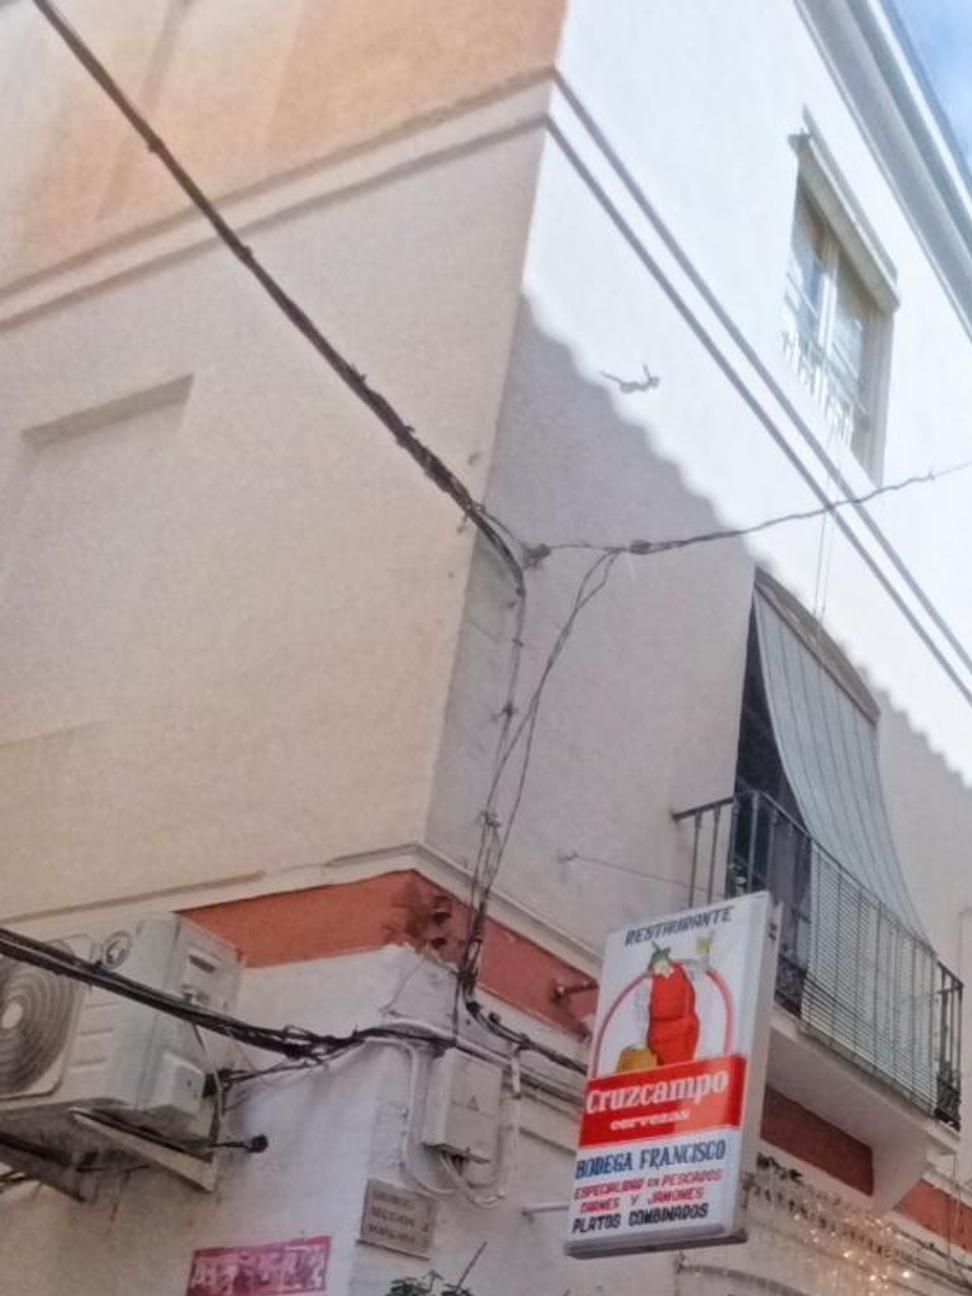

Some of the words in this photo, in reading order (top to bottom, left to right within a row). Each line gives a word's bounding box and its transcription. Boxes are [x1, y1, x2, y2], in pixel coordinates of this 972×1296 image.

[624, 905, 734, 946] RESTAURANTE
[586, 1070, 729, 1114] Cruzcampo
[575, 1152, 633, 1180] BODEGA
[639, 1139, 726, 1170] FRANCISCO
[660, 1168, 722, 1187] PESCADOS
[571, 1213, 622, 1234] PLATOS
[628, 1202, 709, 1227] COMBINADOS
